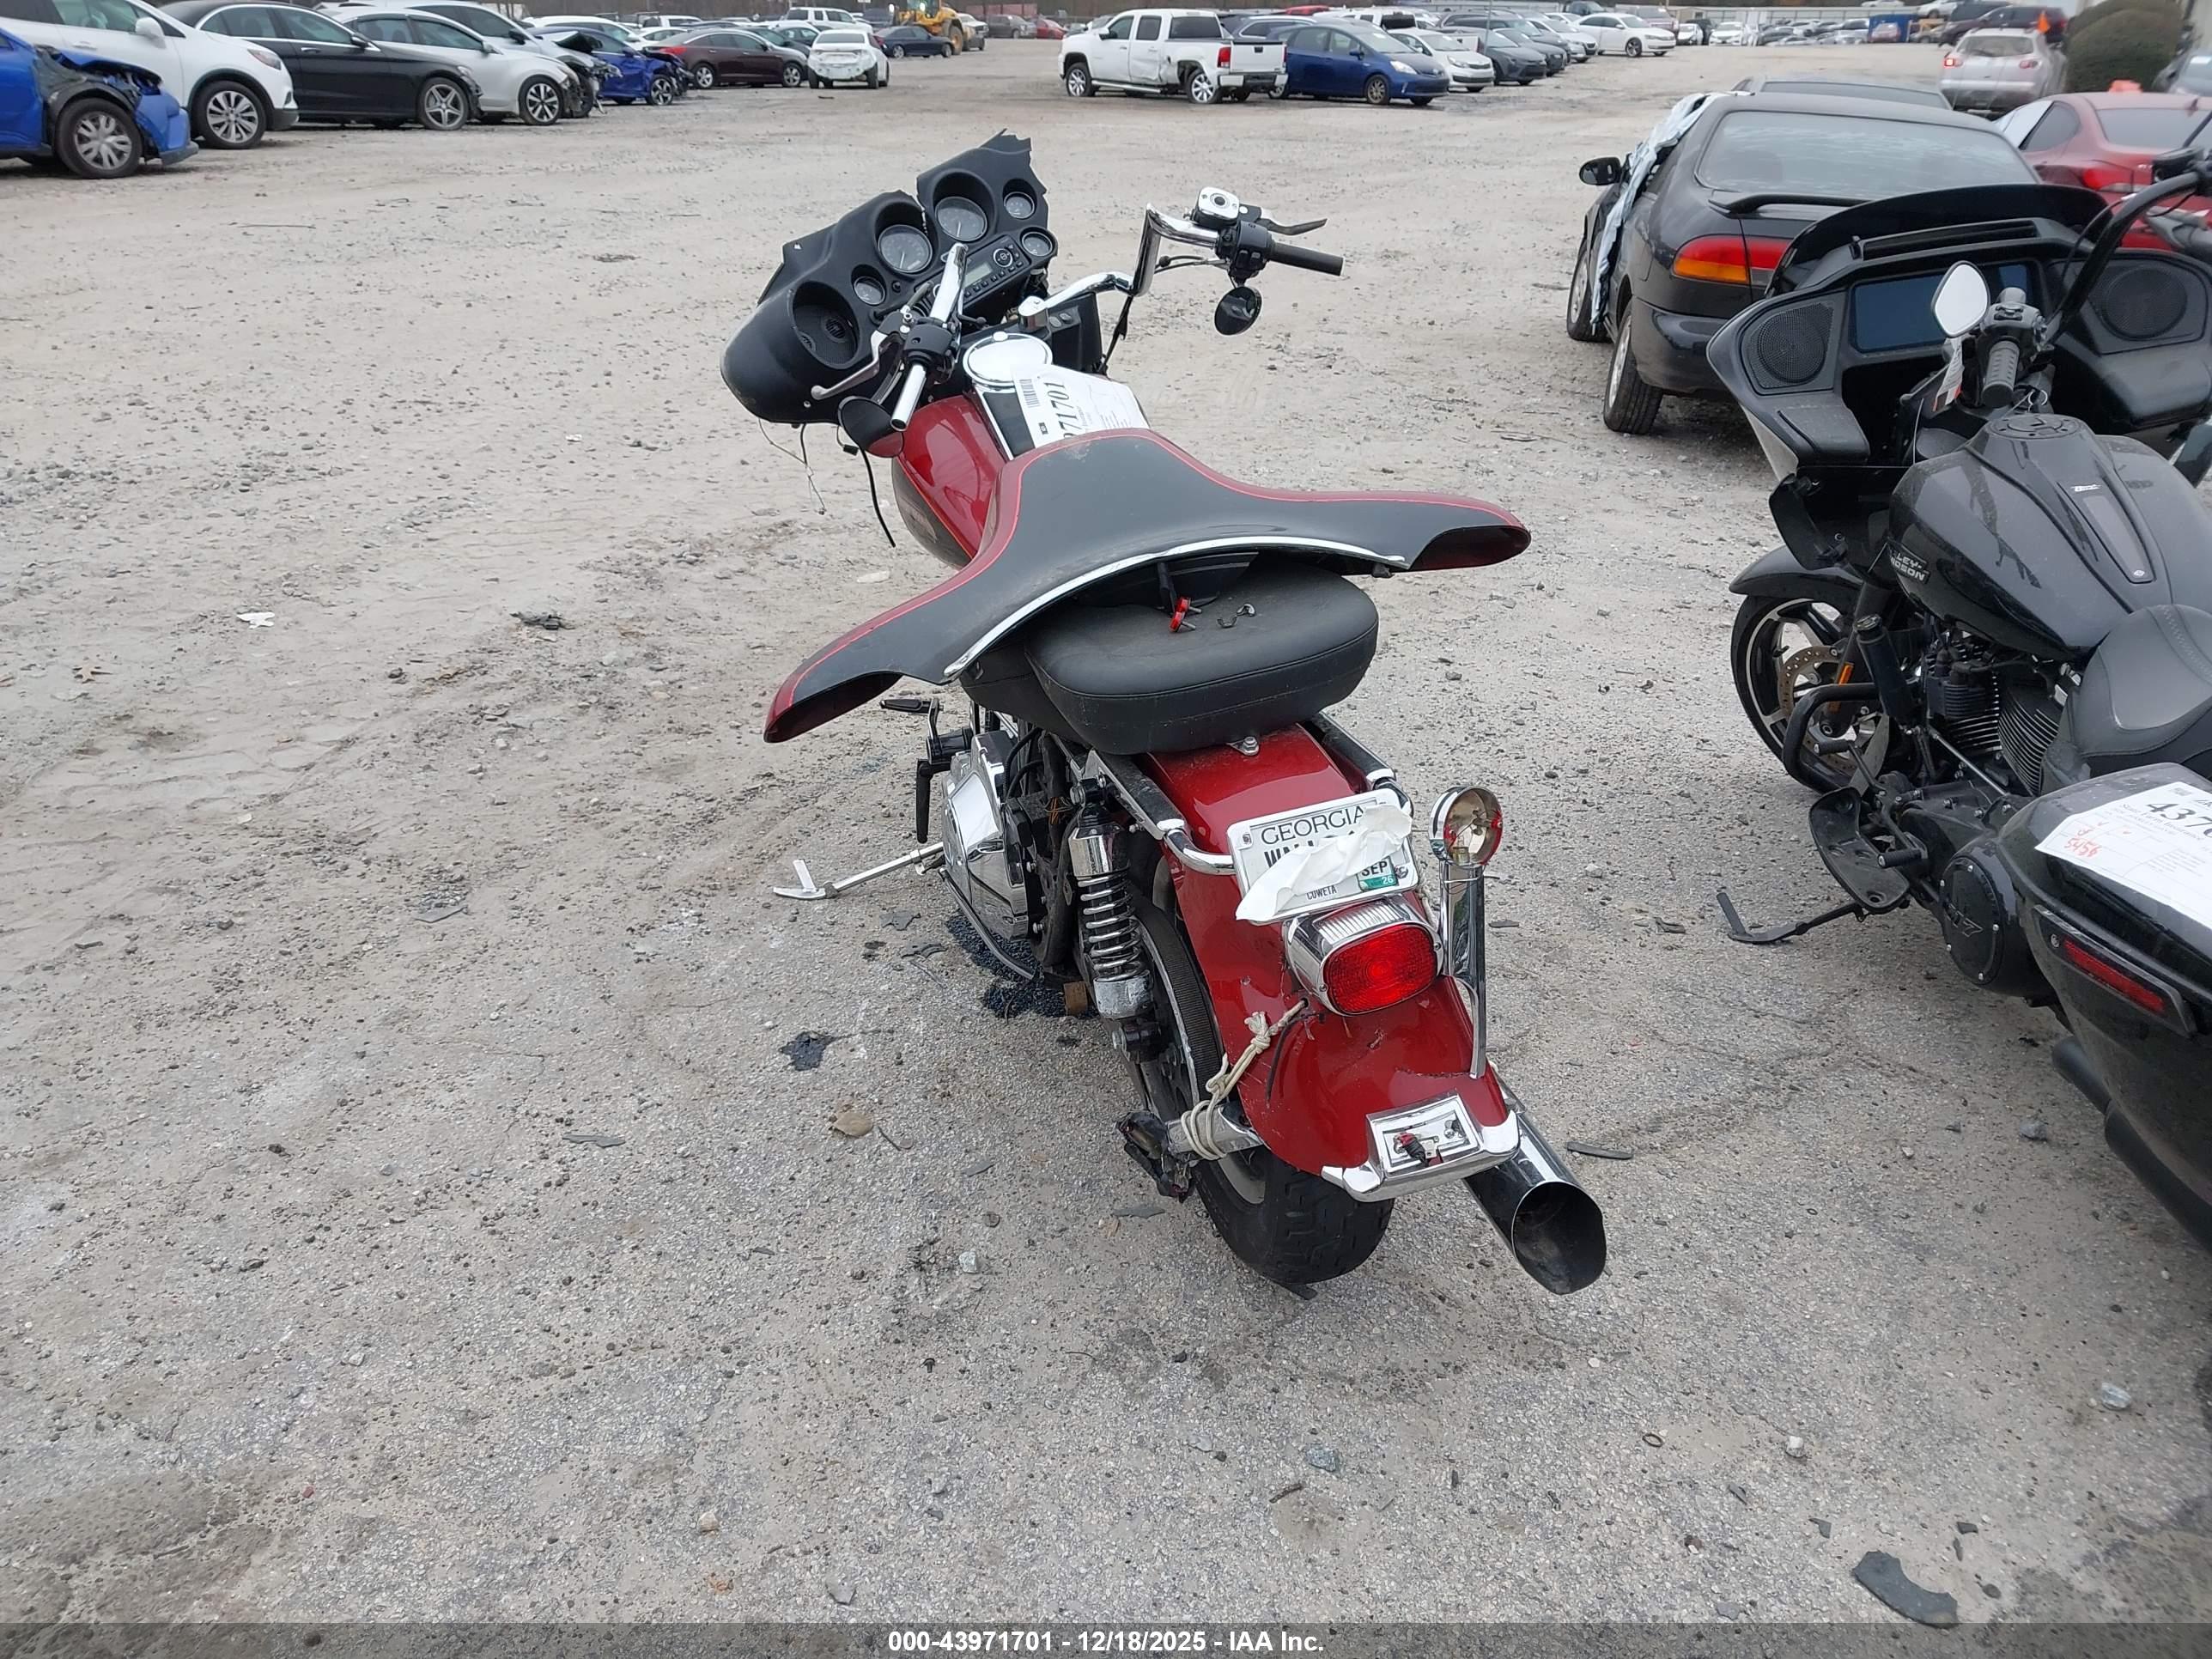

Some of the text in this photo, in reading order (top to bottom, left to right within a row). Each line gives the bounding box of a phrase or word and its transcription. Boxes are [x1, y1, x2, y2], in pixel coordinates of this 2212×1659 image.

[1261, 805, 1364, 845] GEORGIA
[1361, 860, 1388, 877] SEP
[1381, 875, 1394, 884] 26
[1307, 884, 1337, 901] COWETA
